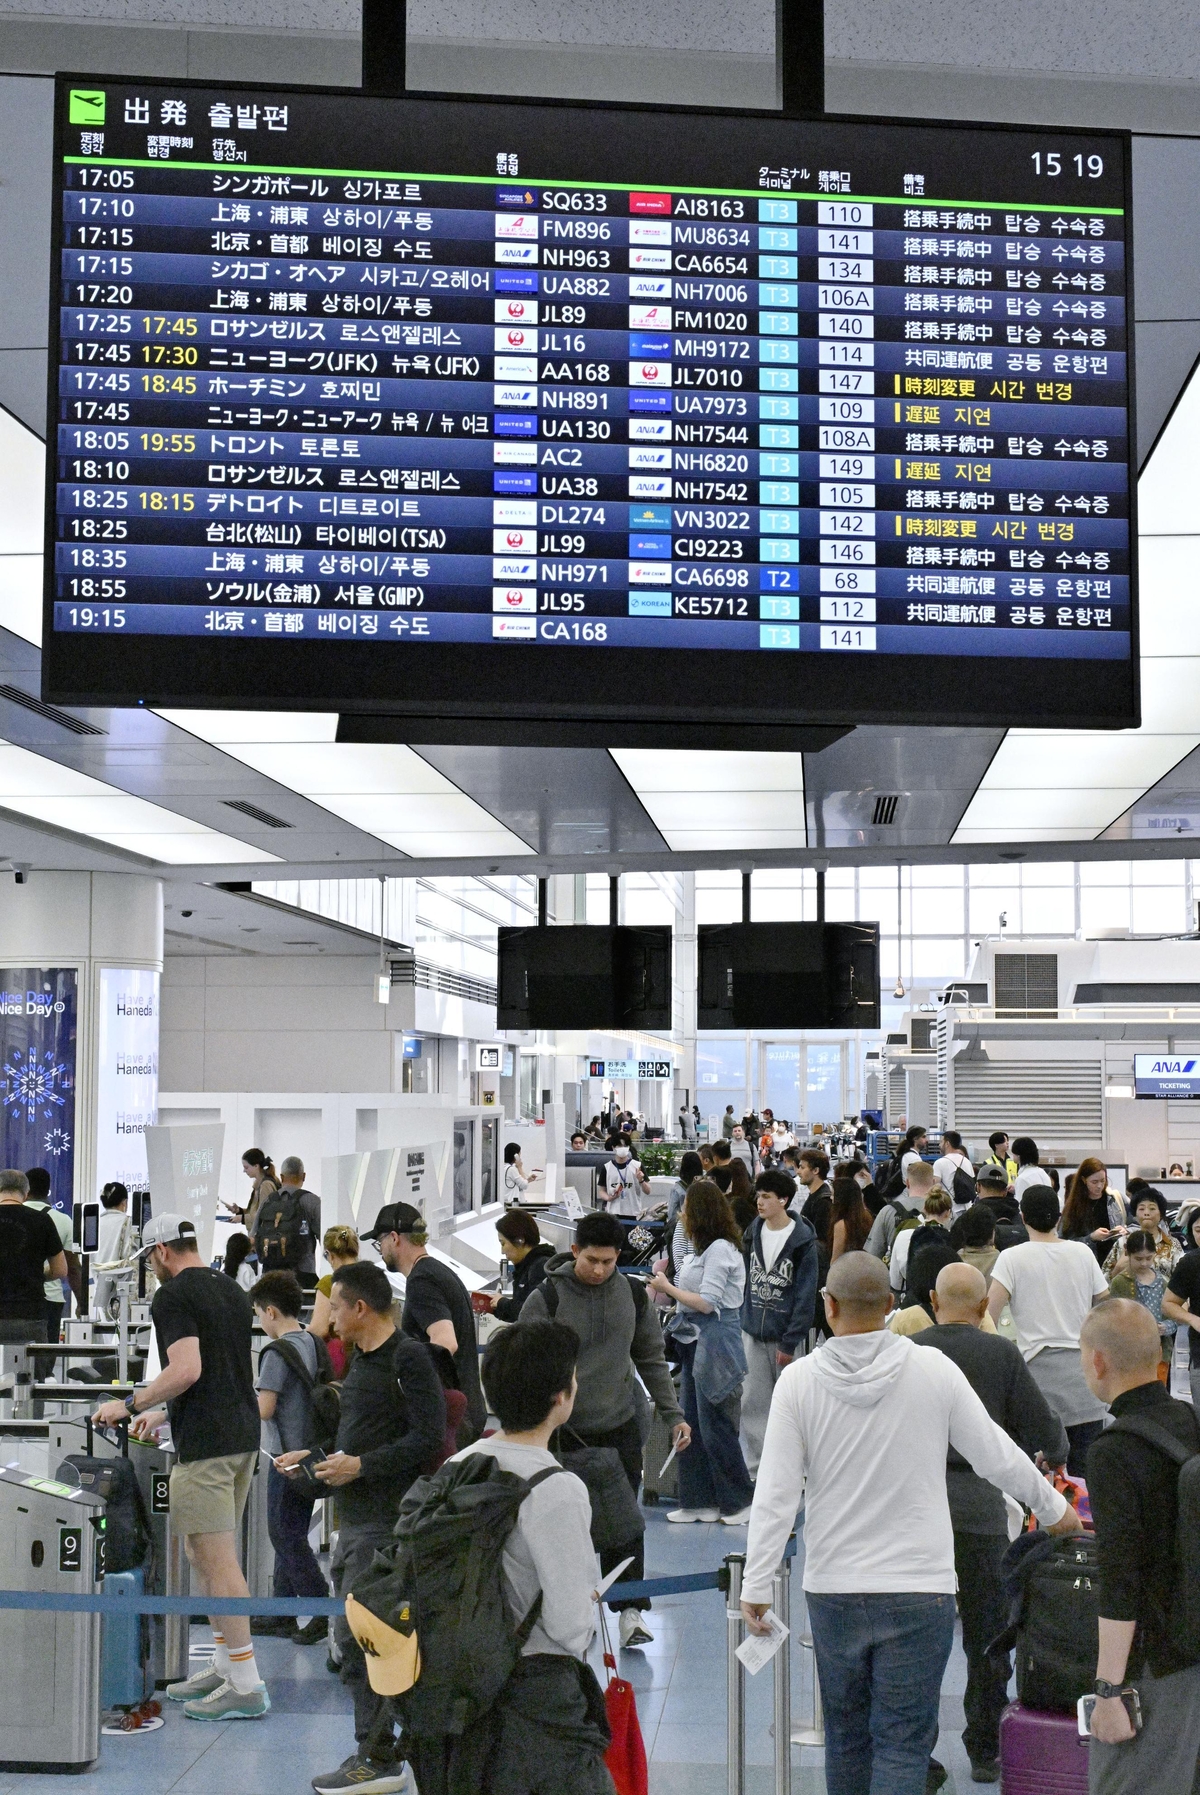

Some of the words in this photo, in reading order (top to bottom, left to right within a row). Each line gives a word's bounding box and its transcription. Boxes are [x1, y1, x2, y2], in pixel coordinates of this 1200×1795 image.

[208, 103, 287, 131] 출발편
[81, 144, 103, 155] 정각
[147, 135, 193, 148] 変更時刻
[212, 138, 236, 150] 行先
[213, 150, 247, 162] 행선지
[1031, 152, 1061, 176] 15
[1074, 154, 1103, 178] 19
[79, 169, 134, 188] 17:05
[759, 167, 810, 179] ターミナル
[818, 171, 850, 182] 搭乗口
[903, 174, 924, 185] 備考
[213, 175, 329, 196] シンガポール
[343, 180, 422, 200] 싱가포르
[759, 178, 791, 189] 터미널
[819, 182, 851, 192] 게이트
[904, 186, 924, 195] 비고
[79, 198, 134, 217] 17:10
[543, 192, 606, 211] SQ633
[674, 199, 744, 218] AI8163
[211, 203, 308, 225] 上海・浦東
[323, 208, 433, 230] 상하이/푸동
[829, 207, 861, 222] 110
[904, 210, 991, 230] 搭乗手続中
[1006, 215, 1040, 233] 탑승
[1051, 217, 1105, 236] 수속중
[78, 227, 133, 246] 17:15
[544, 220, 610, 239] FM896
[675, 227, 750, 246] MU8634
[211, 231, 308, 254] 北京・首都
[323, 236, 381, 257] 베이징
[394, 240, 433, 258] 수도
[829, 234, 858, 250] 141
[77, 256, 132, 275] 17:15
[544, 249, 610, 268] NH963
[675, 255, 748, 273] CA6654
[212, 261, 345, 283] シカゴ・オヘア
[360, 266, 489, 291] 시카고/오헤어
[829, 262, 861, 278] 134
[77, 285, 132, 304] 17:20
[544, 277, 610, 295] UA882
[675, 283, 747, 302] NH7006
[210, 289, 307, 311] 上海・浦東
[322, 294, 432, 316] 상하이/푸동
[822, 291, 869, 306] 106A
[542, 305, 585, 323] JL89
[675, 311, 747, 330] FM1020
[76, 314, 131, 333] 17:25
[143, 317, 197, 335] 17:45
[211, 320, 325, 340] ロサンゼルス
[340, 324, 461, 346] 로스앤젤레스
[830, 318, 862, 334] 140
[542, 334, 585, 352] JL16
[675, 339, 750, 358] MH9172
[76, 343, 130, 362] 17:45
[142, 346, 197, 364] 17:30
[830, 346, 862, 362] 114
[905, 349, 992, 369] 共同運航便
[1007, 354, 1042, 371] 공동
[1053, 355, 1107, 374] 운항편
[209, 351, 377, 373] ニューヨーク(JFK)
[392, 355, 479, 376] 뉴욕(JFK)
[541, 363, 610, 381] AA168
[75, 372, 130, 391] 17:45
[142, 375, 196, 394] 18:45
[674, 368, 742, 387] JL7010
[830, 374, 862, 390] 147
[209, 377, 306, 397] ホーチミン
[320, 381, 380, 401] 호찌민
[906, 378, 975, 397] 時刻変更
[990, 380, 1025, 399] 시간
[1037, 382, 1071, 400] 변경
[543, 391, 607, 409] NH891
[675, 396, 747, 415] UA7973
[74, 402, 129, 420] 17:45
[208, 407, 381, 431] ニューヨーク・ニューアーク
[391, 412, 419, 431] 뉴욕
[426, 413, 433, 431] /
[830, 402, 862, 419] 109
[906, 406, 940, 423] 遅延
[955, 407, 990, 425] 지연
[543, 420, 610, 439] UA130
[675, 425, 748, 443] NH7544
[74, 431, 129, 450] 18:05
[141, 433, 195, 452] 19:55
[211, 435, 284, 455] トロント
[300, 438, 360, 457] 토론토
[823, 431, 870, 447] 108A
[541, 449, 582, 466] AC2
[675, 453, 748, 472] NH6820
[73, 460, 129, 479] 18:10
[831, 459, 862, 475] 149
[543, 477, 598, 496] UA38
[675, 482, 747, 500] NH7542
[831, 487, 863, 503] 105
[72, 490, 127, 509] 18:25
[140, 492, 194, 511] 18:15
[207, 494, 303, 514] デトロイト
[320, 496, 420, 518] 디트로이트
[542, 506, 605, 524] DL274
[674, 511, 750, 529] VN3022
[831, 516, 863, 531] 142
[72, 519, 127, 538] 18:25
[206, 522, 301, 545] 台北(松山)
[317, 525, 446, 548] 타이베이(TSA)
[541, 535, 585, 553] JL99
[675, 539, 743, 558] CI9223
[831, 545, 863, 560] 146
[71, 549, 126, 568] 18:35
[542, 564, 607, 582] NH971
[675, 568, 748, 587] CA6698
[767, 571, 790, 587] T2
[835, 573, 858, 589] 68
[70, 579, 126, 597] 18:55
[207, 582, 320, 604] ソウル(金浦)
[334, 585, 423, 606] 서울(GMP)
[540, 593, 584, 611] JL95
[641, 600, 670, 608] KOREAN
[675, 597, 748, 615] KE5712
[831, 602, 863, 617] 112
[70, 608, 125, 627] 19:15
[541, 622, 607, 641] CA168
[831, 630, 861, 646] 141
[26, 991, 53, 1006] Day
[117, 993, 144, 1006] Have
[26, 1003, 53, 1018] Day
[117, 1003, 153, 1016] Haneda
[117, 1052, 144, 1064] Have
[1151, 1061, 1181, 1073] ANA
[117, 1063, 152, 1075] Haneda
[117, 1111, 144, 1124] Have
[124, 1183, 150, 1194] aneda
[157, 1482, 168, 1498] 8
[64, 1536, 77, 1555] 9
